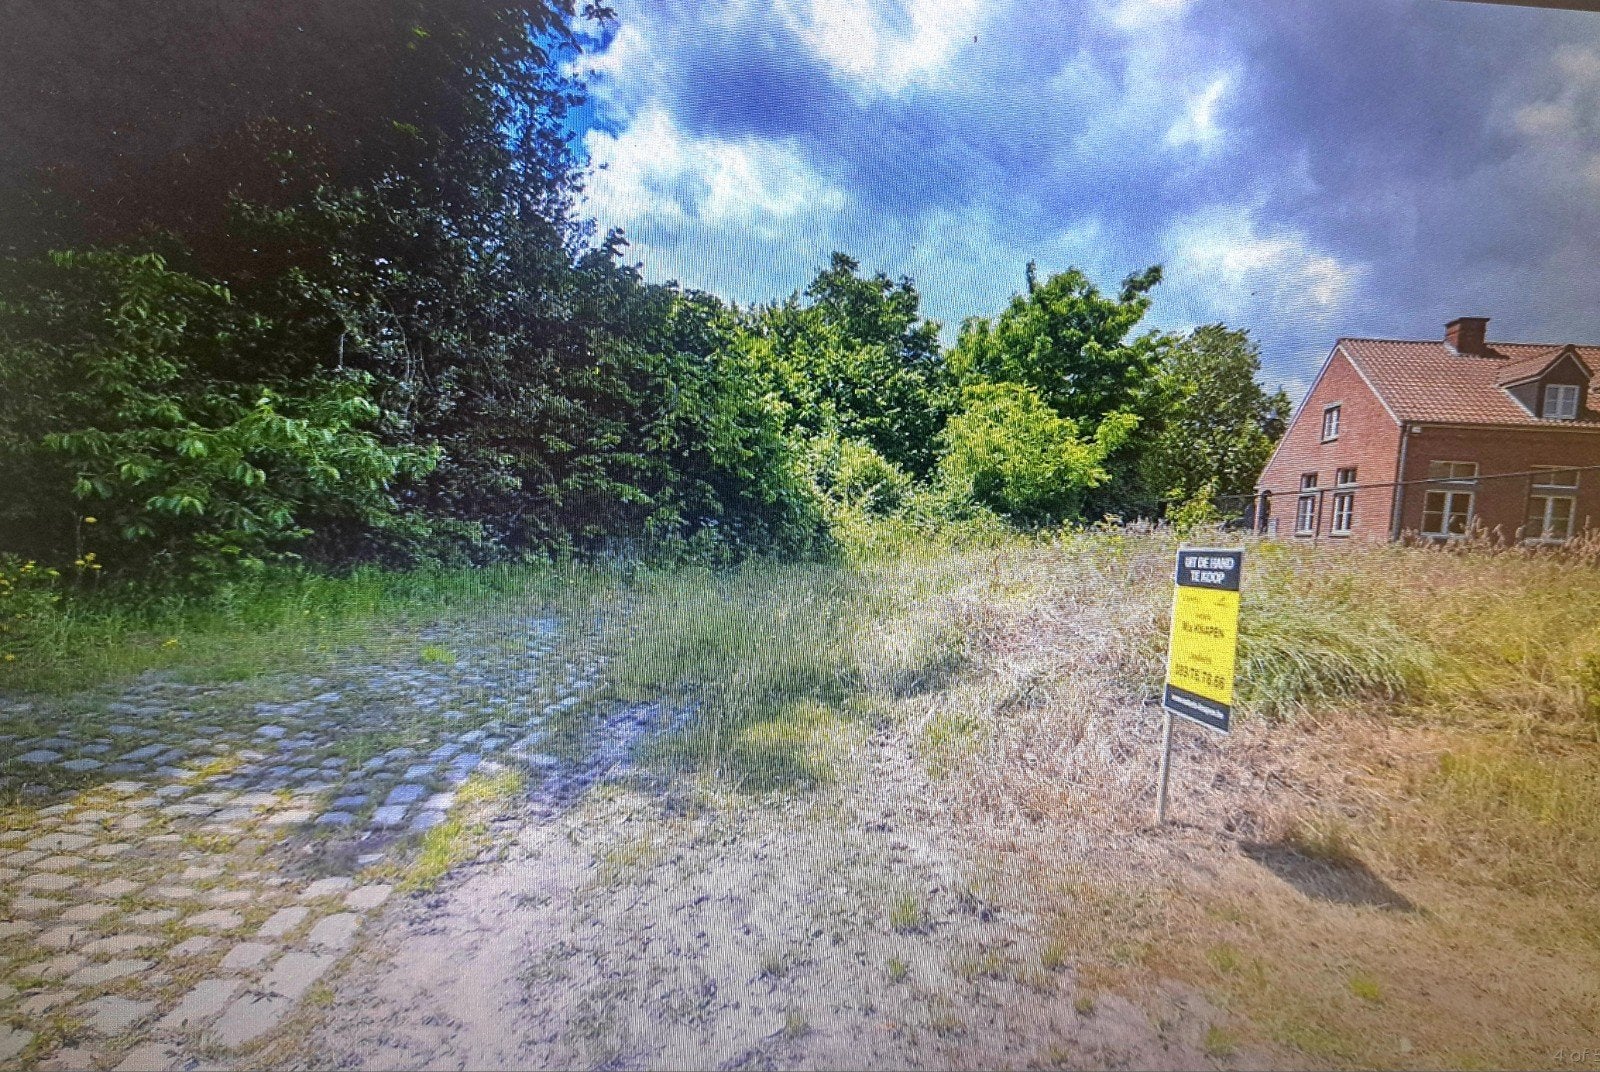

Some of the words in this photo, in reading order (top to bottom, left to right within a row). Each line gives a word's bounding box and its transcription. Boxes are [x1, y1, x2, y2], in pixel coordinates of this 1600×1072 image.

[1198, 556, 1210, 569] DE
[1210, 557, 1235, 570] HAND
[1190, 570, 1200, 582] TE
[1200, 571, 1225, 584] KOOP
